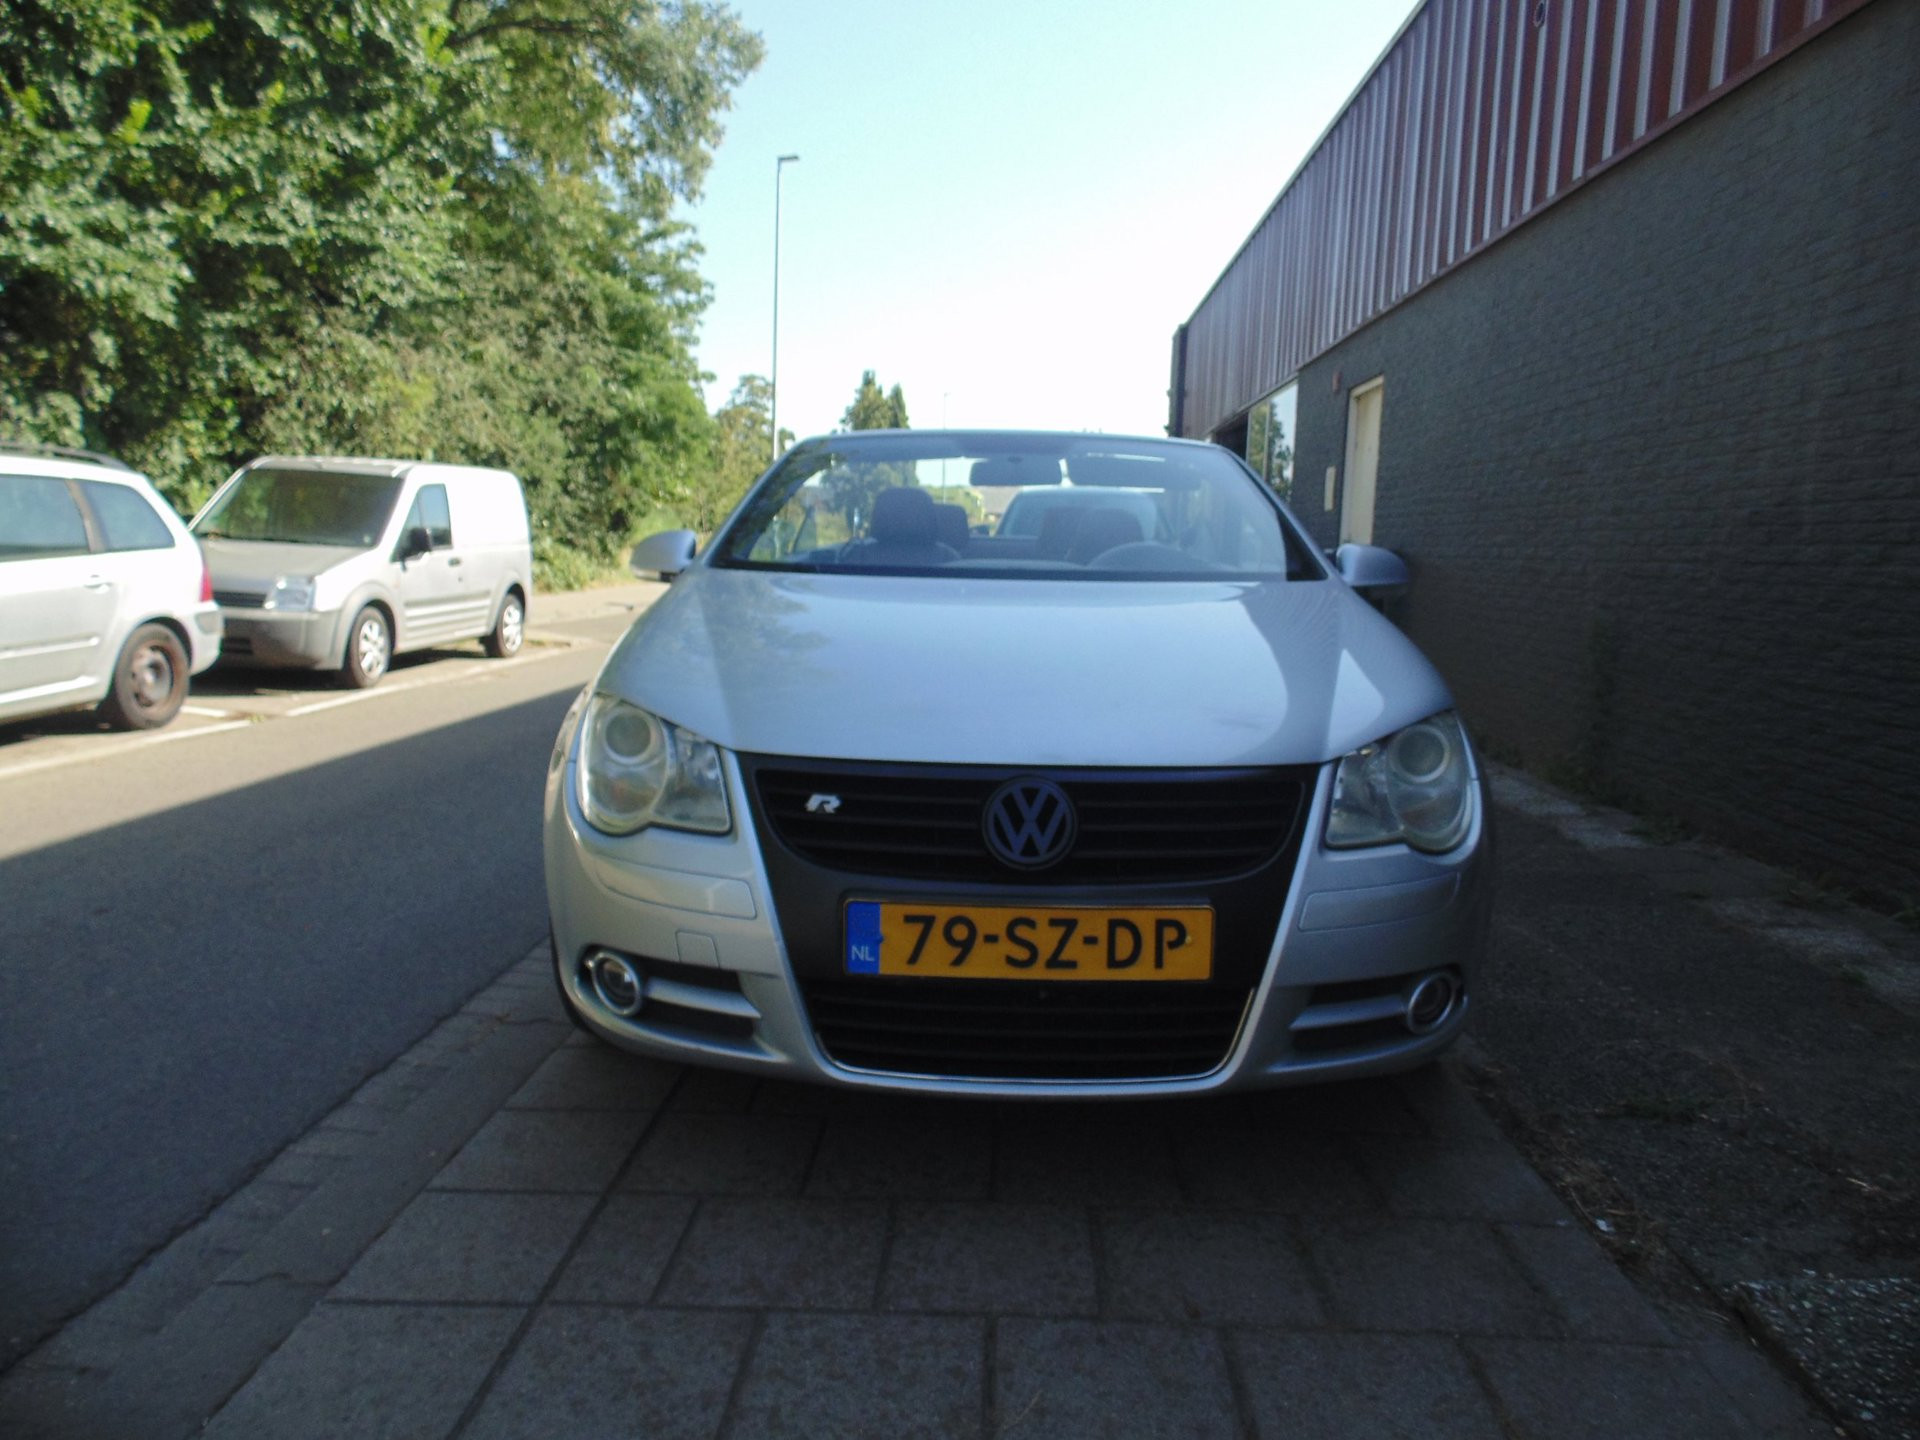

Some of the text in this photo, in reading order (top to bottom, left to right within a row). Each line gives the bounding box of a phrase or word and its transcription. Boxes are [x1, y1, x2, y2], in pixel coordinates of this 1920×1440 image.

[988, 781, 1072, 864] VW
[851, 945, 875, 961] NL
[903, 914, 1188, 970] 79-SZ-DP
